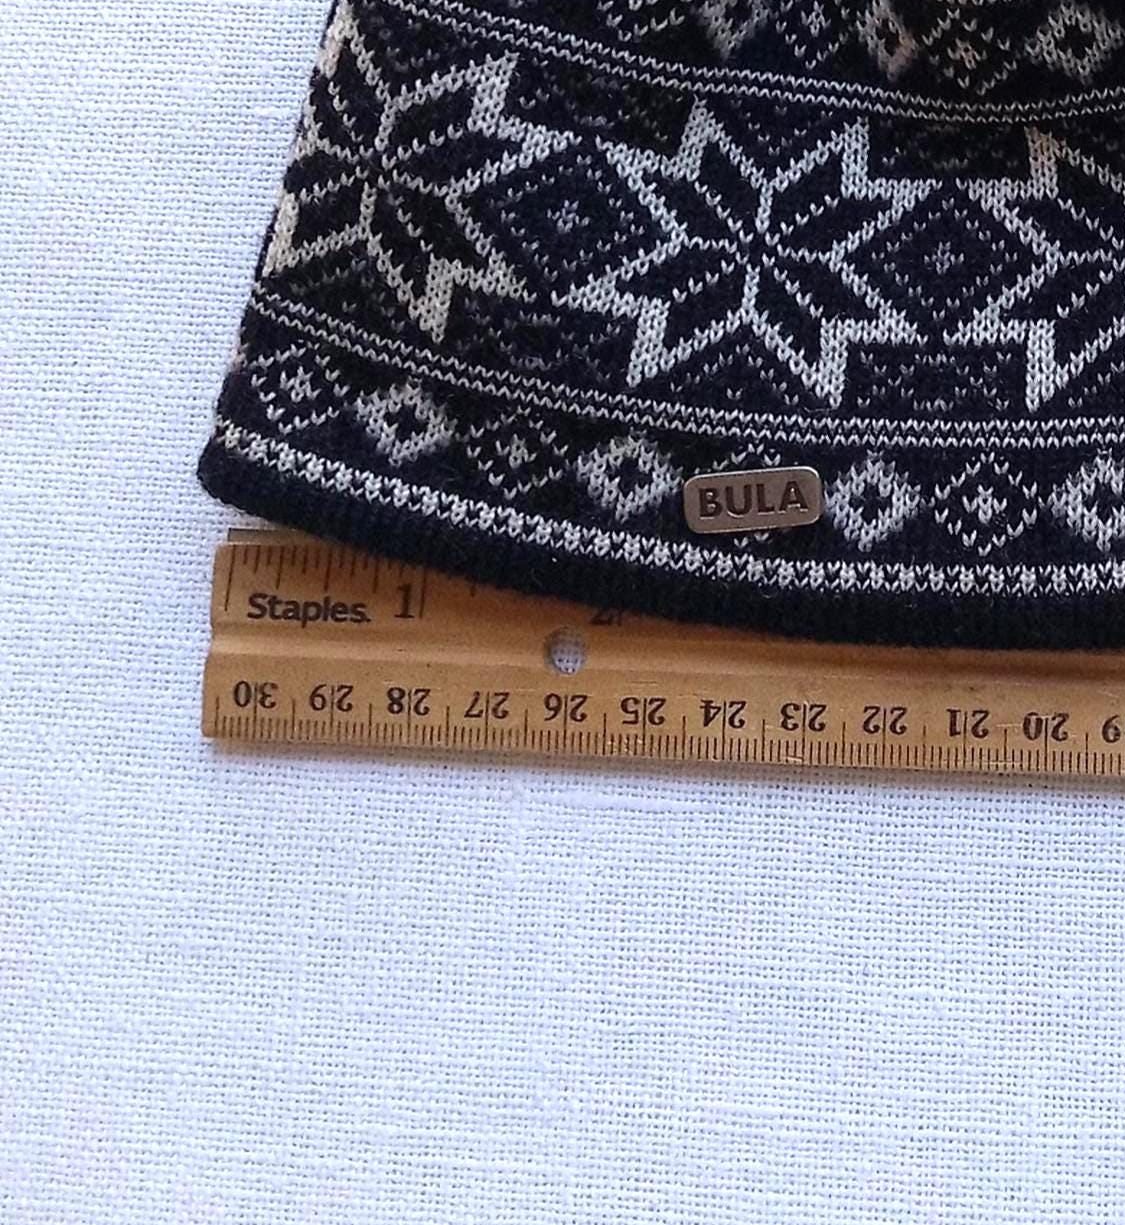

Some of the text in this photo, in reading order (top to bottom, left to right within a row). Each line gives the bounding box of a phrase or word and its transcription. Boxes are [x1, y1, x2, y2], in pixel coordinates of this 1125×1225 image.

[699, 480, 808, 520] BULA
[394, 583, 415, 619] 1
[233, 681, 278, 709] 30
[309, 683, 354, 712] 29
[387, 687, 431, 715] 28
[465, 691, 510, 719] 27
[544, 693, 588, 721] 26
[620, 697, 667, 725] 25
[701, 700, 747, 728] 24
[780, 703, 827, 732] 23
[863, 706, 908, 735] 22
[947, 709, 990, 738] 21
[1023, 712, 1069, 740] 20
